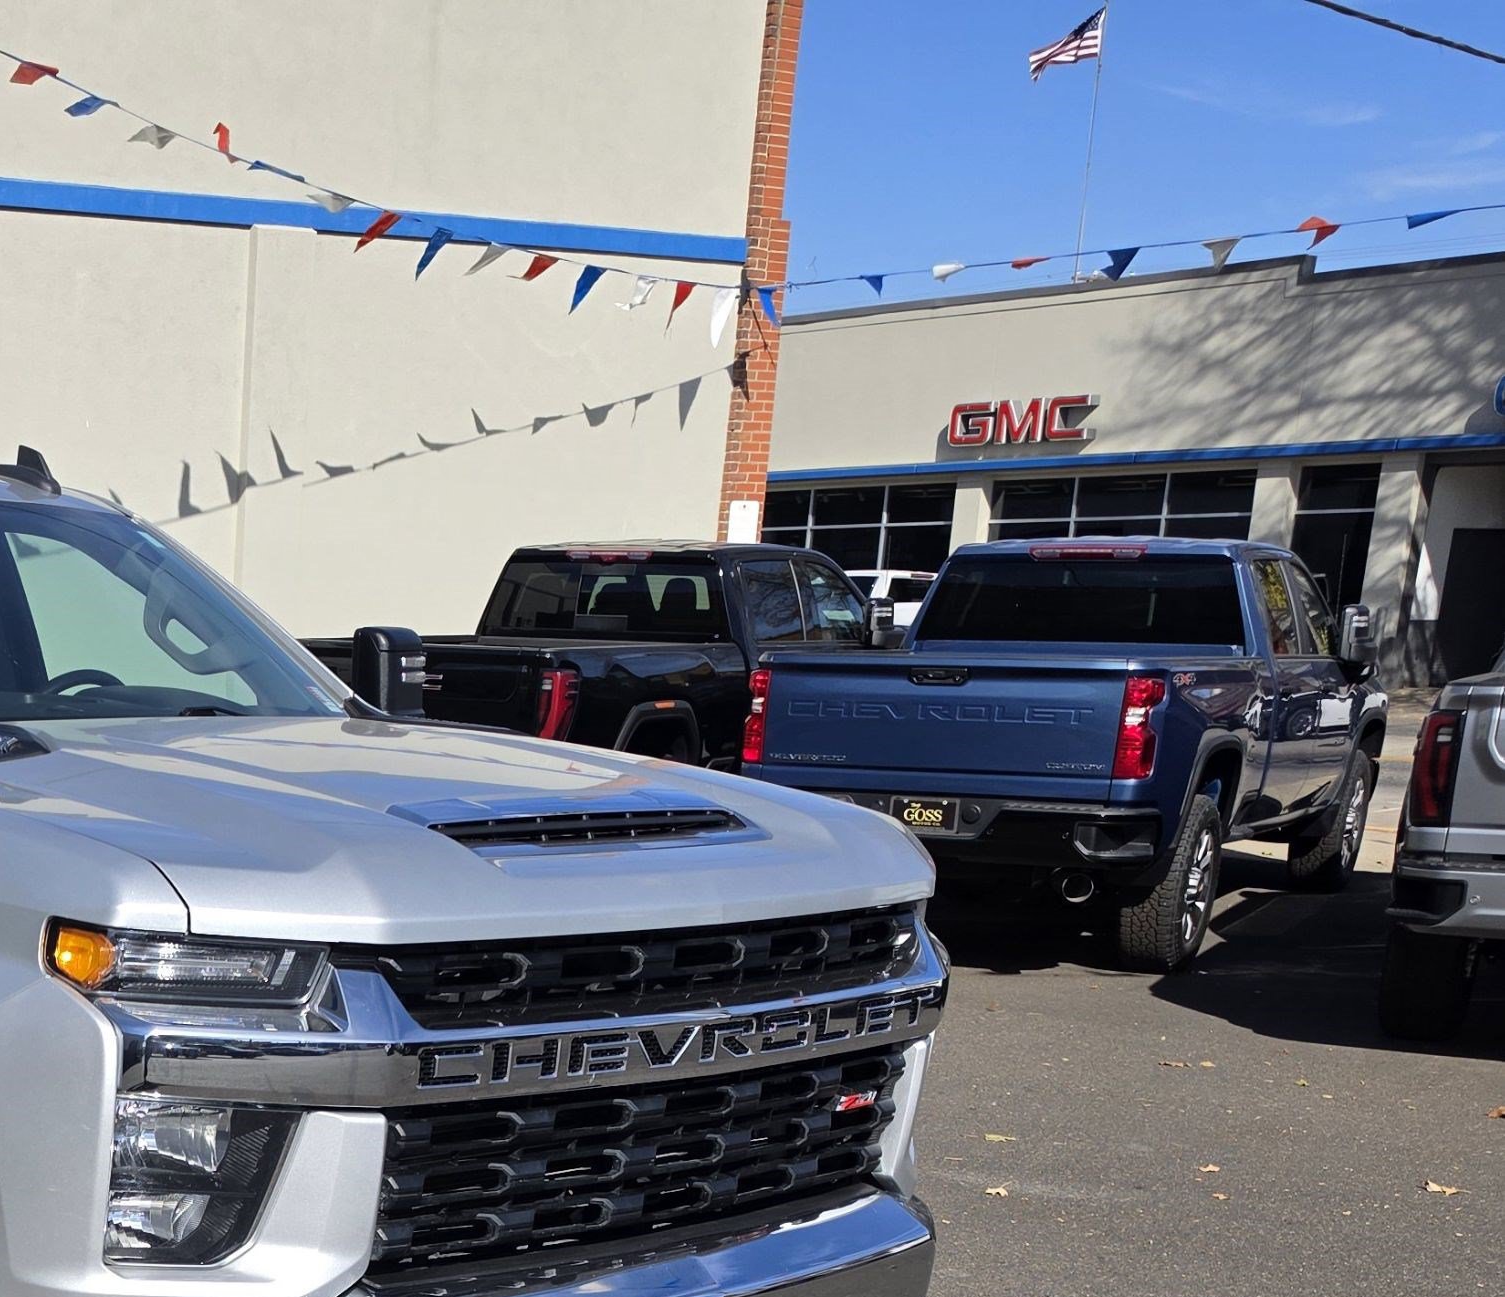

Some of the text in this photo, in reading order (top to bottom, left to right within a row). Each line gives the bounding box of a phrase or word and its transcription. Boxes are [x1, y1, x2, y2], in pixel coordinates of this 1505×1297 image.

[947, 393, 1096, 447] GMC
[787, 700, 1094, 725] CHEVROLET
[903, 808, 943, 822] GOSS
[416, 987, 936, 1089] CHEVROLET
